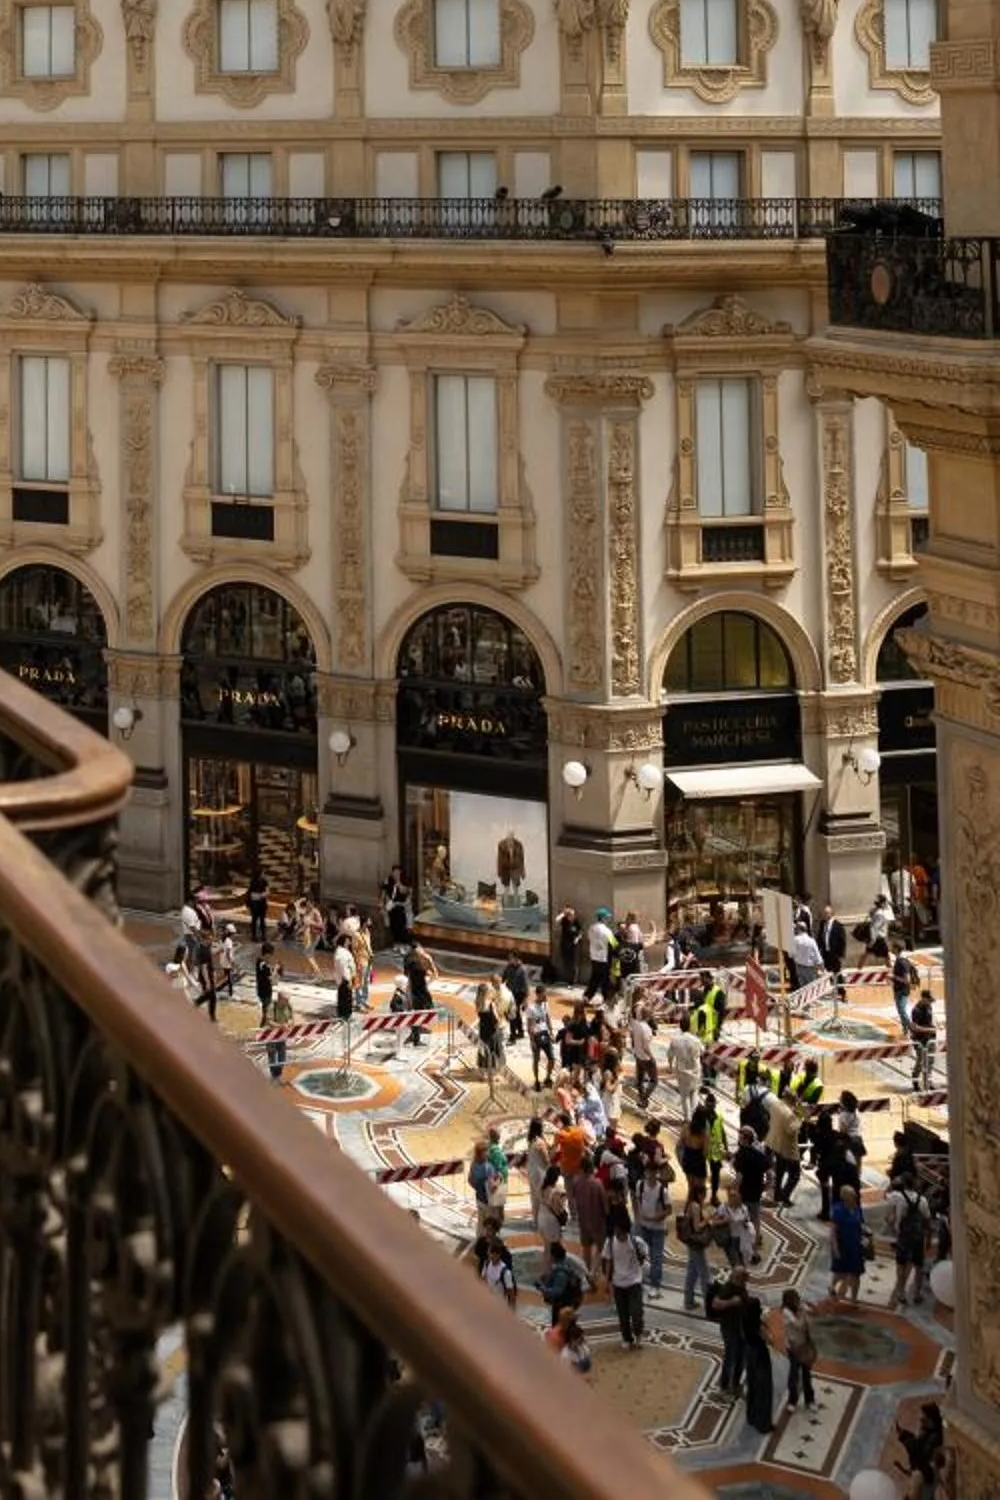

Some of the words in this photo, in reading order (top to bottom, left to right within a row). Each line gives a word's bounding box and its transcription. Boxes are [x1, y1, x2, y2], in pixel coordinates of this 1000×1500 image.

[19, 665, 76, 684] PRADA
[218, 688, 282, 707] PRADA
[437, 715, 505, 734] PRADA
